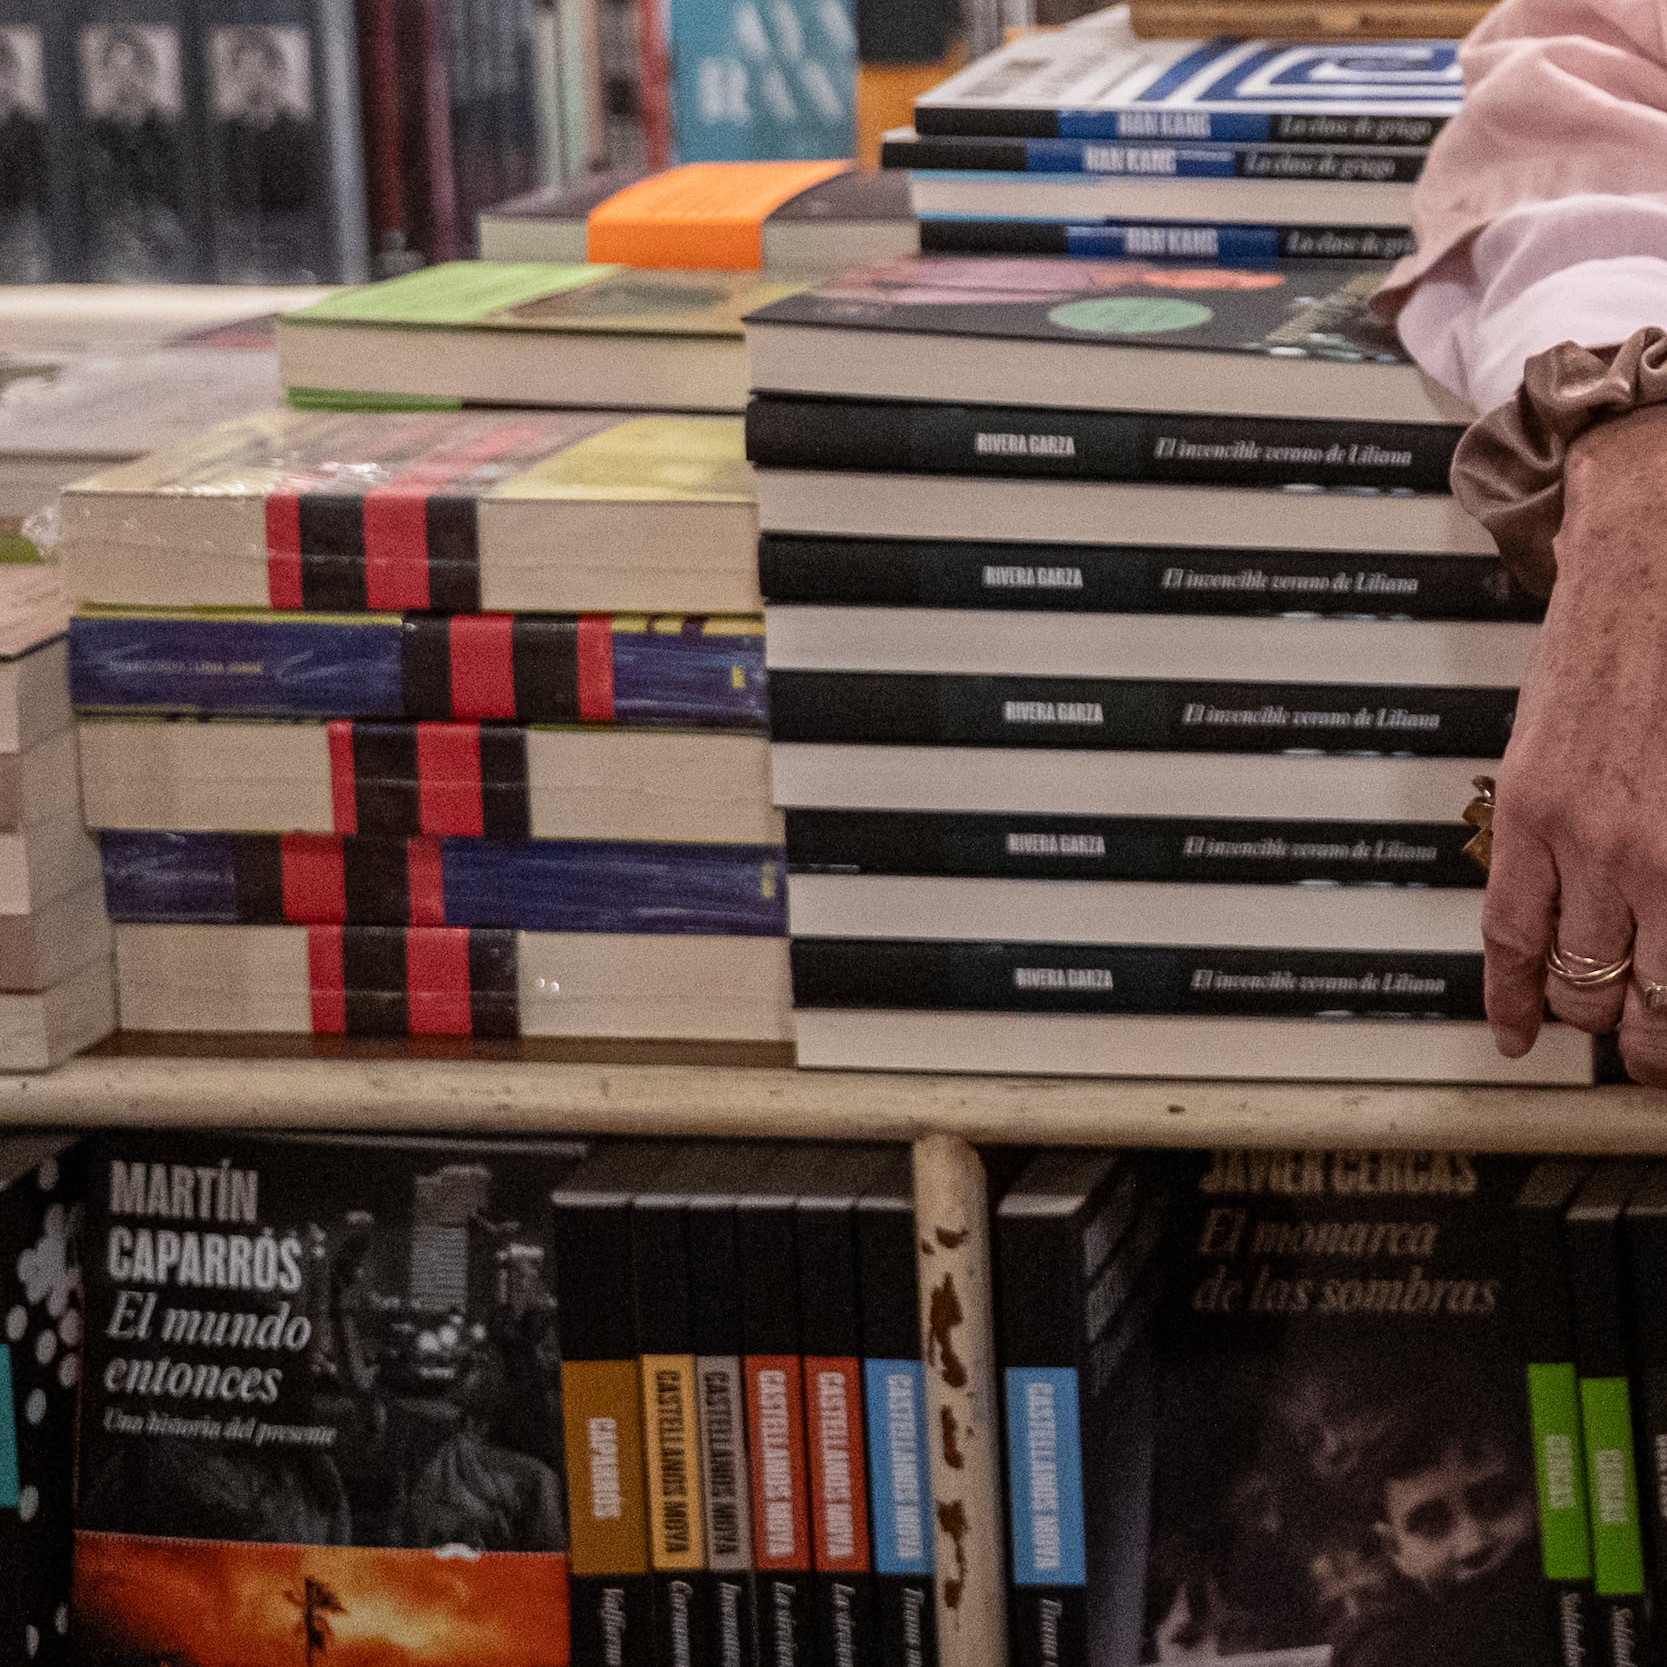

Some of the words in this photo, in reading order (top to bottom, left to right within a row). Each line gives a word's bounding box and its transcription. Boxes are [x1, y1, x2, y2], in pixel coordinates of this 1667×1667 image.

[975, 433, 1028, 455] RIVERA
[1030, 435, 1076, 457] GARZA
[1154, 437, 1175, 459] El
[1176, 440, 1259, 462] invencible
[1265, 446, 1323, 464] verano
[1325, 444, 1345, 465] de
[1348, 444, 1412, 466] Liliana
[984, 566, 1034, 588] RIVERA
[1036, 567, 1083, 590] GARZA
[1162, 567, 1183, 589] El
[1185, 570, 1267, 591] invencible
[1269, 575, 1329, 592] verano
[1330, 573, 1352, 592] de
[1354, 572, 1419, 594] Liliana
[1004, 700, 1055, 723] RIVERA
[1057, 702, 1103, 724] GARZA
[1183, 703, 1205, 725] El
[1207, 705, 1289, 727] invencible
[1293, 710, 1350, 728] verano
[1352, 708, 1373, 728] de
[1376, 708, 1440, 730] Liliana
[1007, 834, 1057, 855] RIVERA
[1060, 835, 1105, 857] GARZA
[1184, 836, 1205, 858] El
[1206, 837, 1290, 859] invencible
[1293, 842, 1348, 860] verano
[1350, 840, 1371, 860] de
[1374, 840, 1438, 863] Liliana
[1015, 968, 1065, 989] RIVERA
[1067, 969, 1113, 990] GARZA
[1191, 969, 1214, 989] El
[1215, 971, 1297, 990] invencible
[1300, 974, 1358, 992] verano
[1360, 972, 1379, 992] de
[1382, 972, 1446, 994] Liliana
[109, 1158, 258, 1223] MARTÍN
[109, 1225, 301, 1293] CAPARRÓS
[1200, 1208, 1246, 1256] El
[1251, 1221, 1437, 1258] monarca
[1192, 1264, 1244, 1311] de
[1250, 1263, 1310, 1312] las
[1319, 1264, 1497, 1314] sombras
[107, 1290, 158, 1340] El
[162, 1300, 312, 1351] mundo
[104, 1356, 283, 1404] entonces
[103, 1405, 145, 1434] Una
[147, 1411, 222, 1439] historia
[223, 1416, 255, 1439] del
[255, 1423, 338, 1447] presente
[656, 1369, 687, 1498] CASTELLANOS
[705, 1370, 736, 1498] CASTELLANOS
[759, 1369, 791, 1500] CASTELLANOS
[818, 1371, 850, 1500] CASTELLANOS
[888, 1373, 919, 1503] CASTELLANOS
[1026, 1382, 1058, 1512] CASTELLANOS
[588, 1416, 624, 1519] CAPARRÓS
[663, 1501, 690, 1554] MOYA
[712, 1501, 739, 1555] MOYA
[765, 1501, 794, 1557] MOYA
[824, 1502, 854, 1558] MOYA
[895, 1505, 923, 1559] MOYA
[1031, 1514, 1061, 1570] MOYA
[774, 1582, 797, 1610] La
[833, 1583, 856, 1611] La
